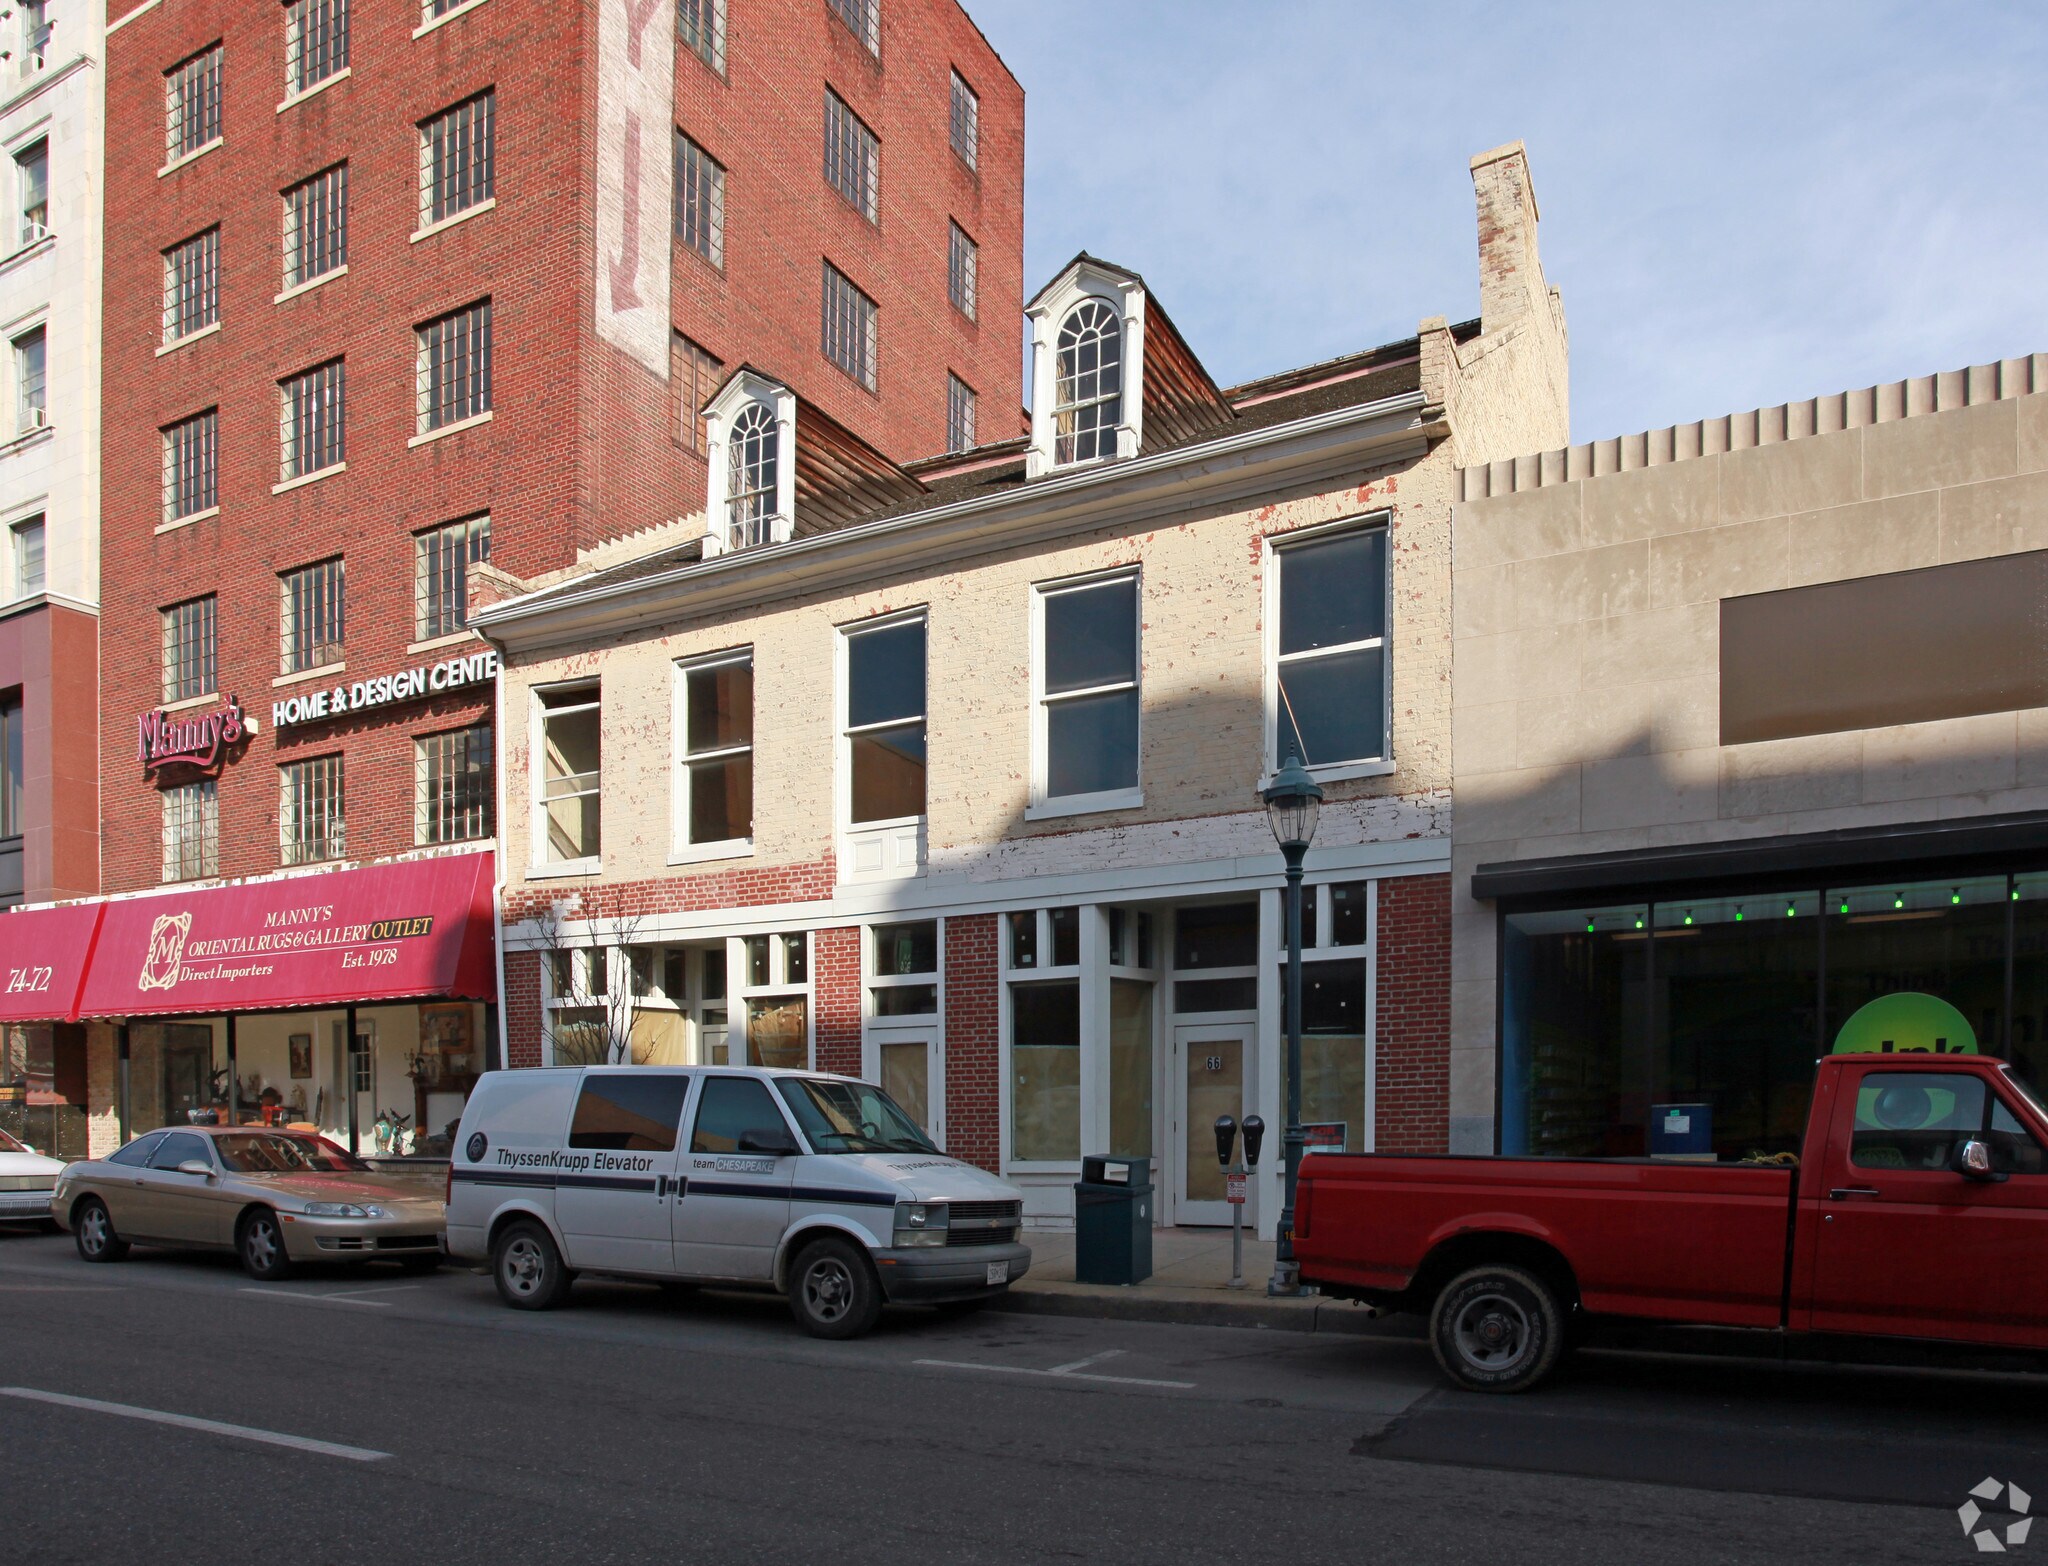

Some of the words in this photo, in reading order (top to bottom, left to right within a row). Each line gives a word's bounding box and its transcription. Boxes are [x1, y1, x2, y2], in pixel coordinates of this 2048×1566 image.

[273, 691, 329, 727] HOME
[329, 687, 348, 713] &
[350, 667, 426, 709] DESIGN
[430, 651, 497, 690] CENTE
[137, 694, 242, 769] Manny's
[264, 904, 333, 928] MANNY'S
[188, 935, 256, 957] ORIENTAL
[371, 917, 433, 940] OUTLET
[153, 935, 178, 964] M
[341, 951, 366, 968] Est.
[368, 948, 398, 967] 1978
[4, 965, 53, 993] 74-72
[180, 966, 215, 982] Direct
[216, 963, 273, 982] Importers
[1207, 1057, 1220, 1069] 66
[497, 1149, 590, 1173] ThyssenKrupp
[593, 1152, 654, 1172] Elevator
[693, 1159, 715, 1169] team
[717, 1160, 774, 1173] CHESAPEAKE
